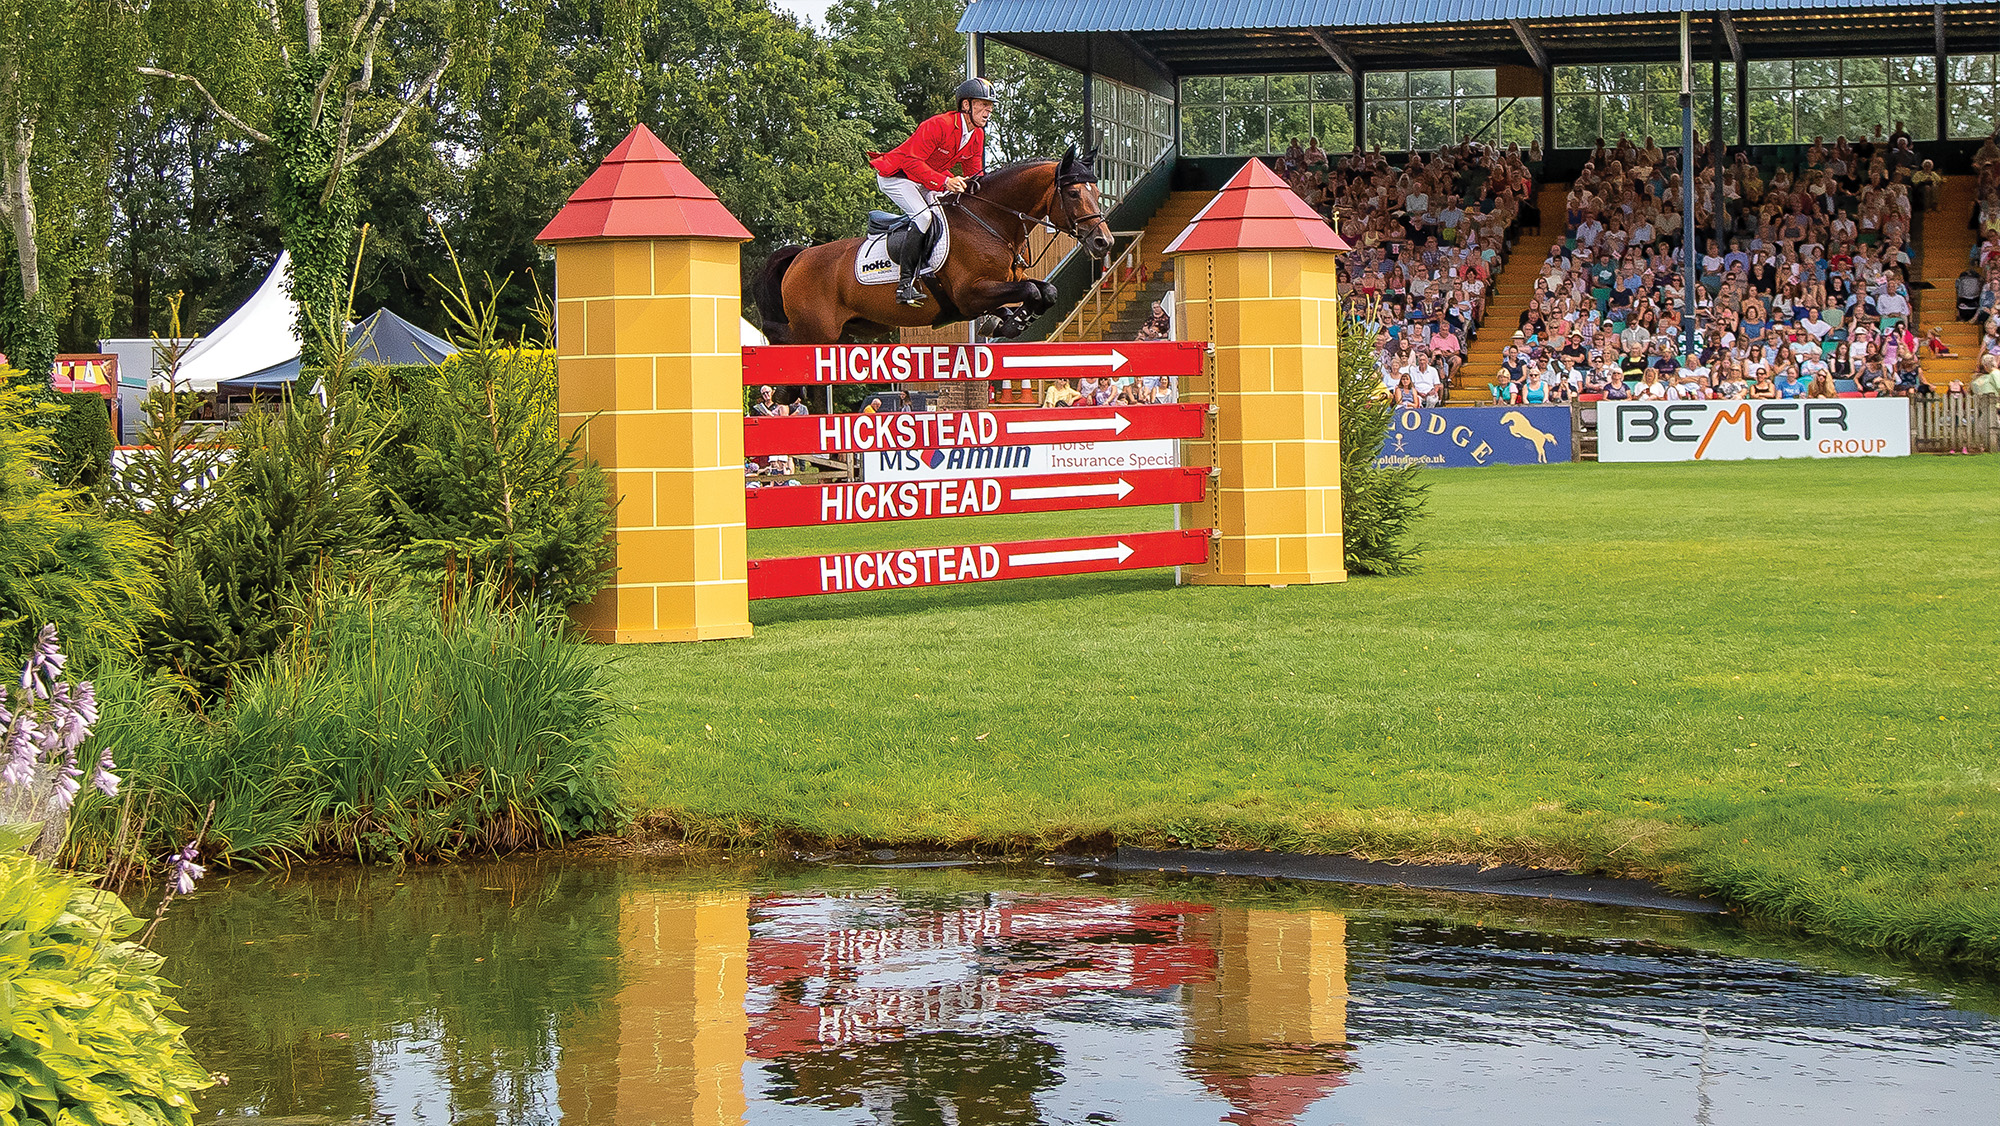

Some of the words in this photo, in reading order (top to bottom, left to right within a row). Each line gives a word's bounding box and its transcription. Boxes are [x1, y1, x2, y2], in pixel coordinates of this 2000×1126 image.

[815, 346, 994, 381] HICKSTEAD
[819, 411, 998, 450] HICKSTEAD
[1617, 403, 1848, 460] BEMER
[1818, 439, 1886, 454] GROUP
[880, 450, 920, 471] MS
[1051, 454, 1125, 468] Insurance
[1129, 453, 1180, 468] Specia
[821, 479, 1002, 521] HICKSTEAD
[819, 545, 1000, 592] HICKSTEAD
